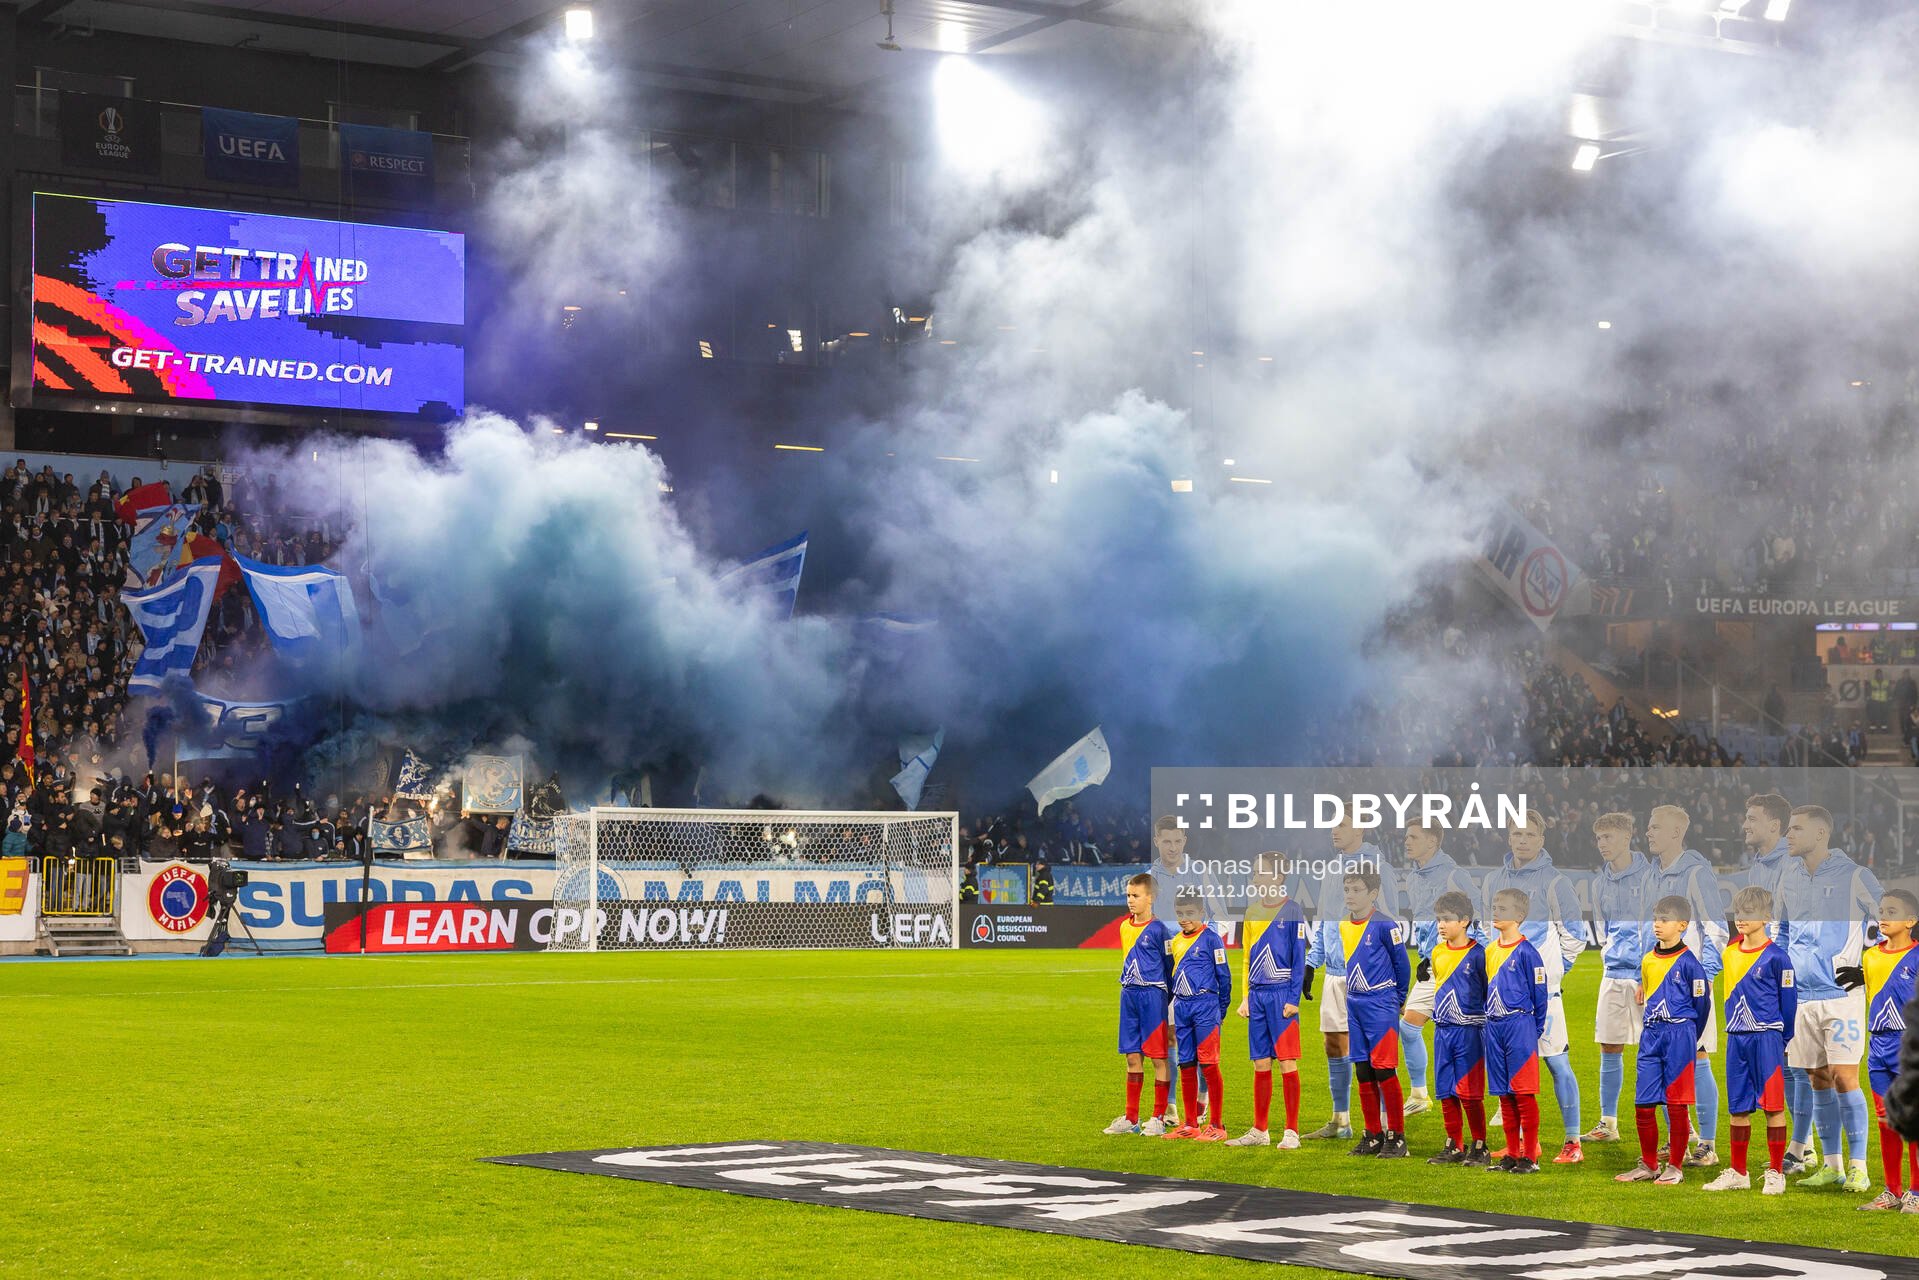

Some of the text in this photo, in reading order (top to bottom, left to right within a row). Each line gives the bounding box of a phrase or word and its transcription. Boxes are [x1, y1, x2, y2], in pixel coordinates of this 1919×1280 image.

[95, 142, 131, 153] EUROPA
[98, 149, 129, 159] LEAGUE
[219, 135, 285, 161] UEFA
[369, 155, 425, 172] RESPECT
[152, 242, 249, 280] GET
[174, 287, 354, 327] SAVE LIVES
[111, 346, 393, 386] GET-TRAINED.COM
[1696, 597, 1899, 616] UEFA EUROPA LEAGUE
[162, 868, 196, 884] UEFA
[159, 913, 197, 930] MAFIA
[382, 908, 728, 945] LEARN CPR NOW!
[871, 913, 951, 943] UEFA
[997, 915, 1033, 923] EUROPEAN
[997, 925, 1048, 933] RESUSCITATION
[1832, 1018, 1860, 1042] 25
